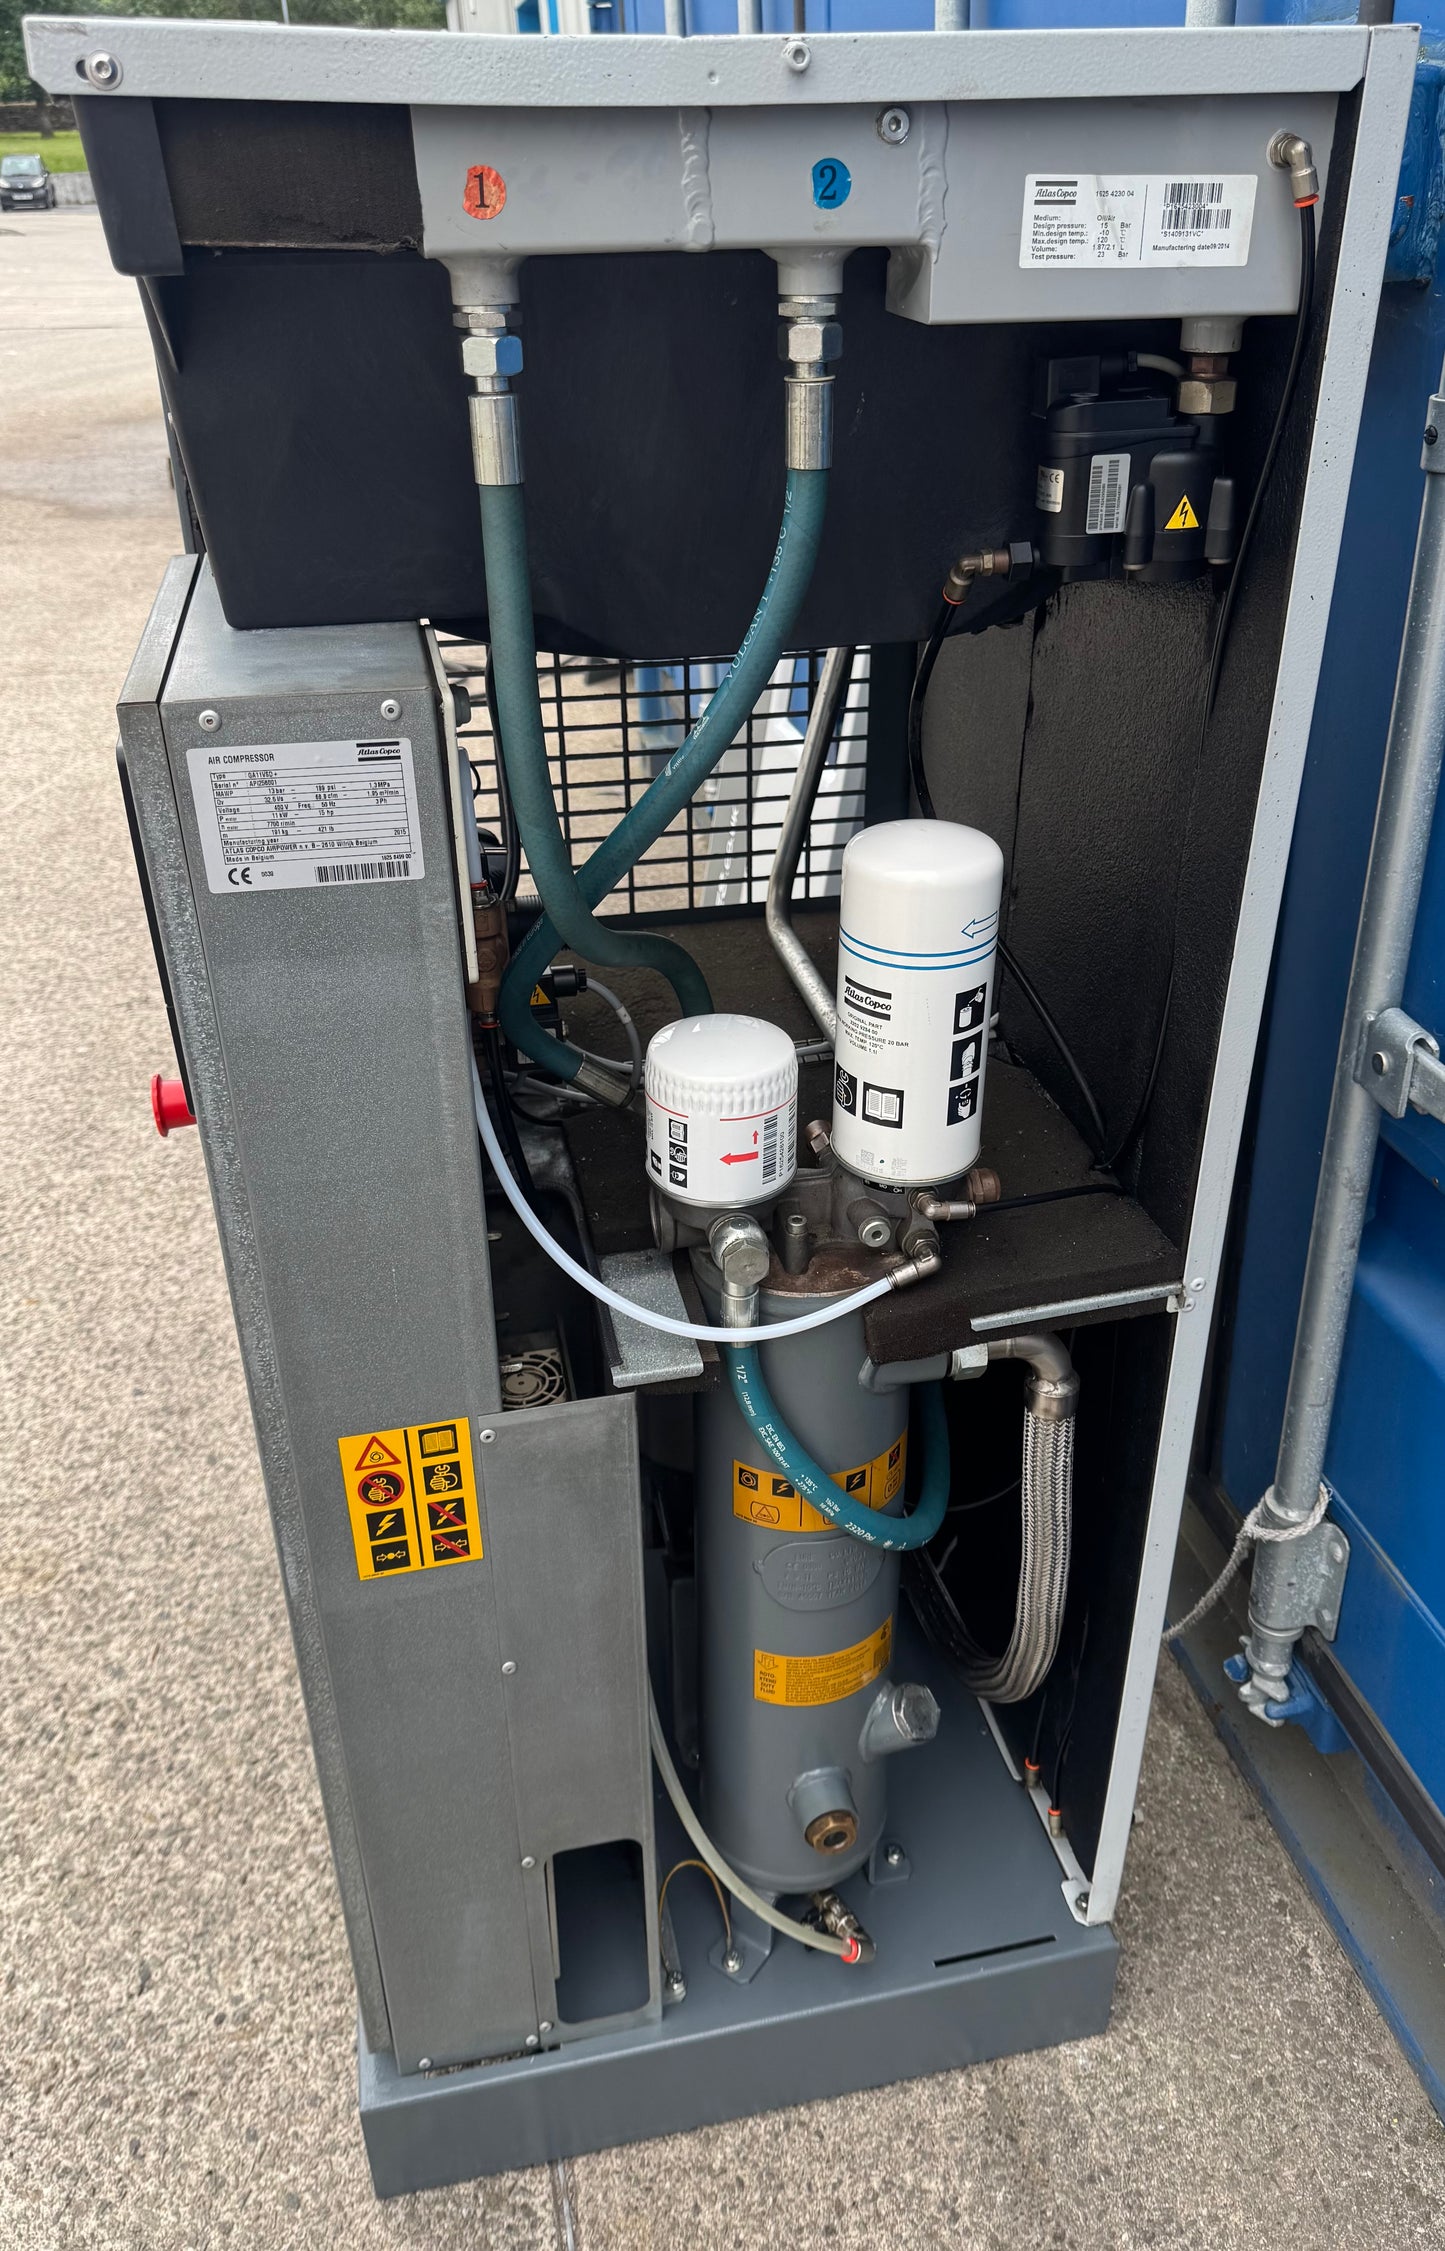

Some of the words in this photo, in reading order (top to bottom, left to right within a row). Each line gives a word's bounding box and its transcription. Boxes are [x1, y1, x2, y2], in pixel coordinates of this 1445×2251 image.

[818, 164, 838, 200] 2
[473, 171, 490, 209] 1
[1035, 188, 1057, 198] Atlas
[1056, 188, 1078, 199] Copco
[1032, 222, 1056, 231] Design
[1056, 222, 1087, 231] pressure:
[1120, 221, 1132, 229] Bar
[1045, 253, 1076, 261] pressure:
[725, 607, 764, 679] VULCAN
[357, 748, 379, 756] Atlas
[379, 747, 401, 755] Copco
[208, 756, 221, 765] AIR
[222, 753, 275, 764] COMPRESSOR
[217, 807, 240, 815] Voltage
[223, 838, 265, 847] Manufacturing
[394, 828, 407, 836] 2015
[225, 847, 244, 855] ATLAS
[266, 843, 298, 852] AIRPOWER
[251, 854, 275, 862] Belgium
[844, 985, 864, 1003] Atlas
[864, 996, 892, 1012] Copco
[868, 1021, 883, 1030] PART
[858, 1029, 887, 1045] PRESSURE
[849, 1038, 868, 1052] VOLUME
[735, 1364, 749, 1384] 1/2"
[772, 1447, 782, 1458] 100
[844, 1521, 866, 1537] 2320
